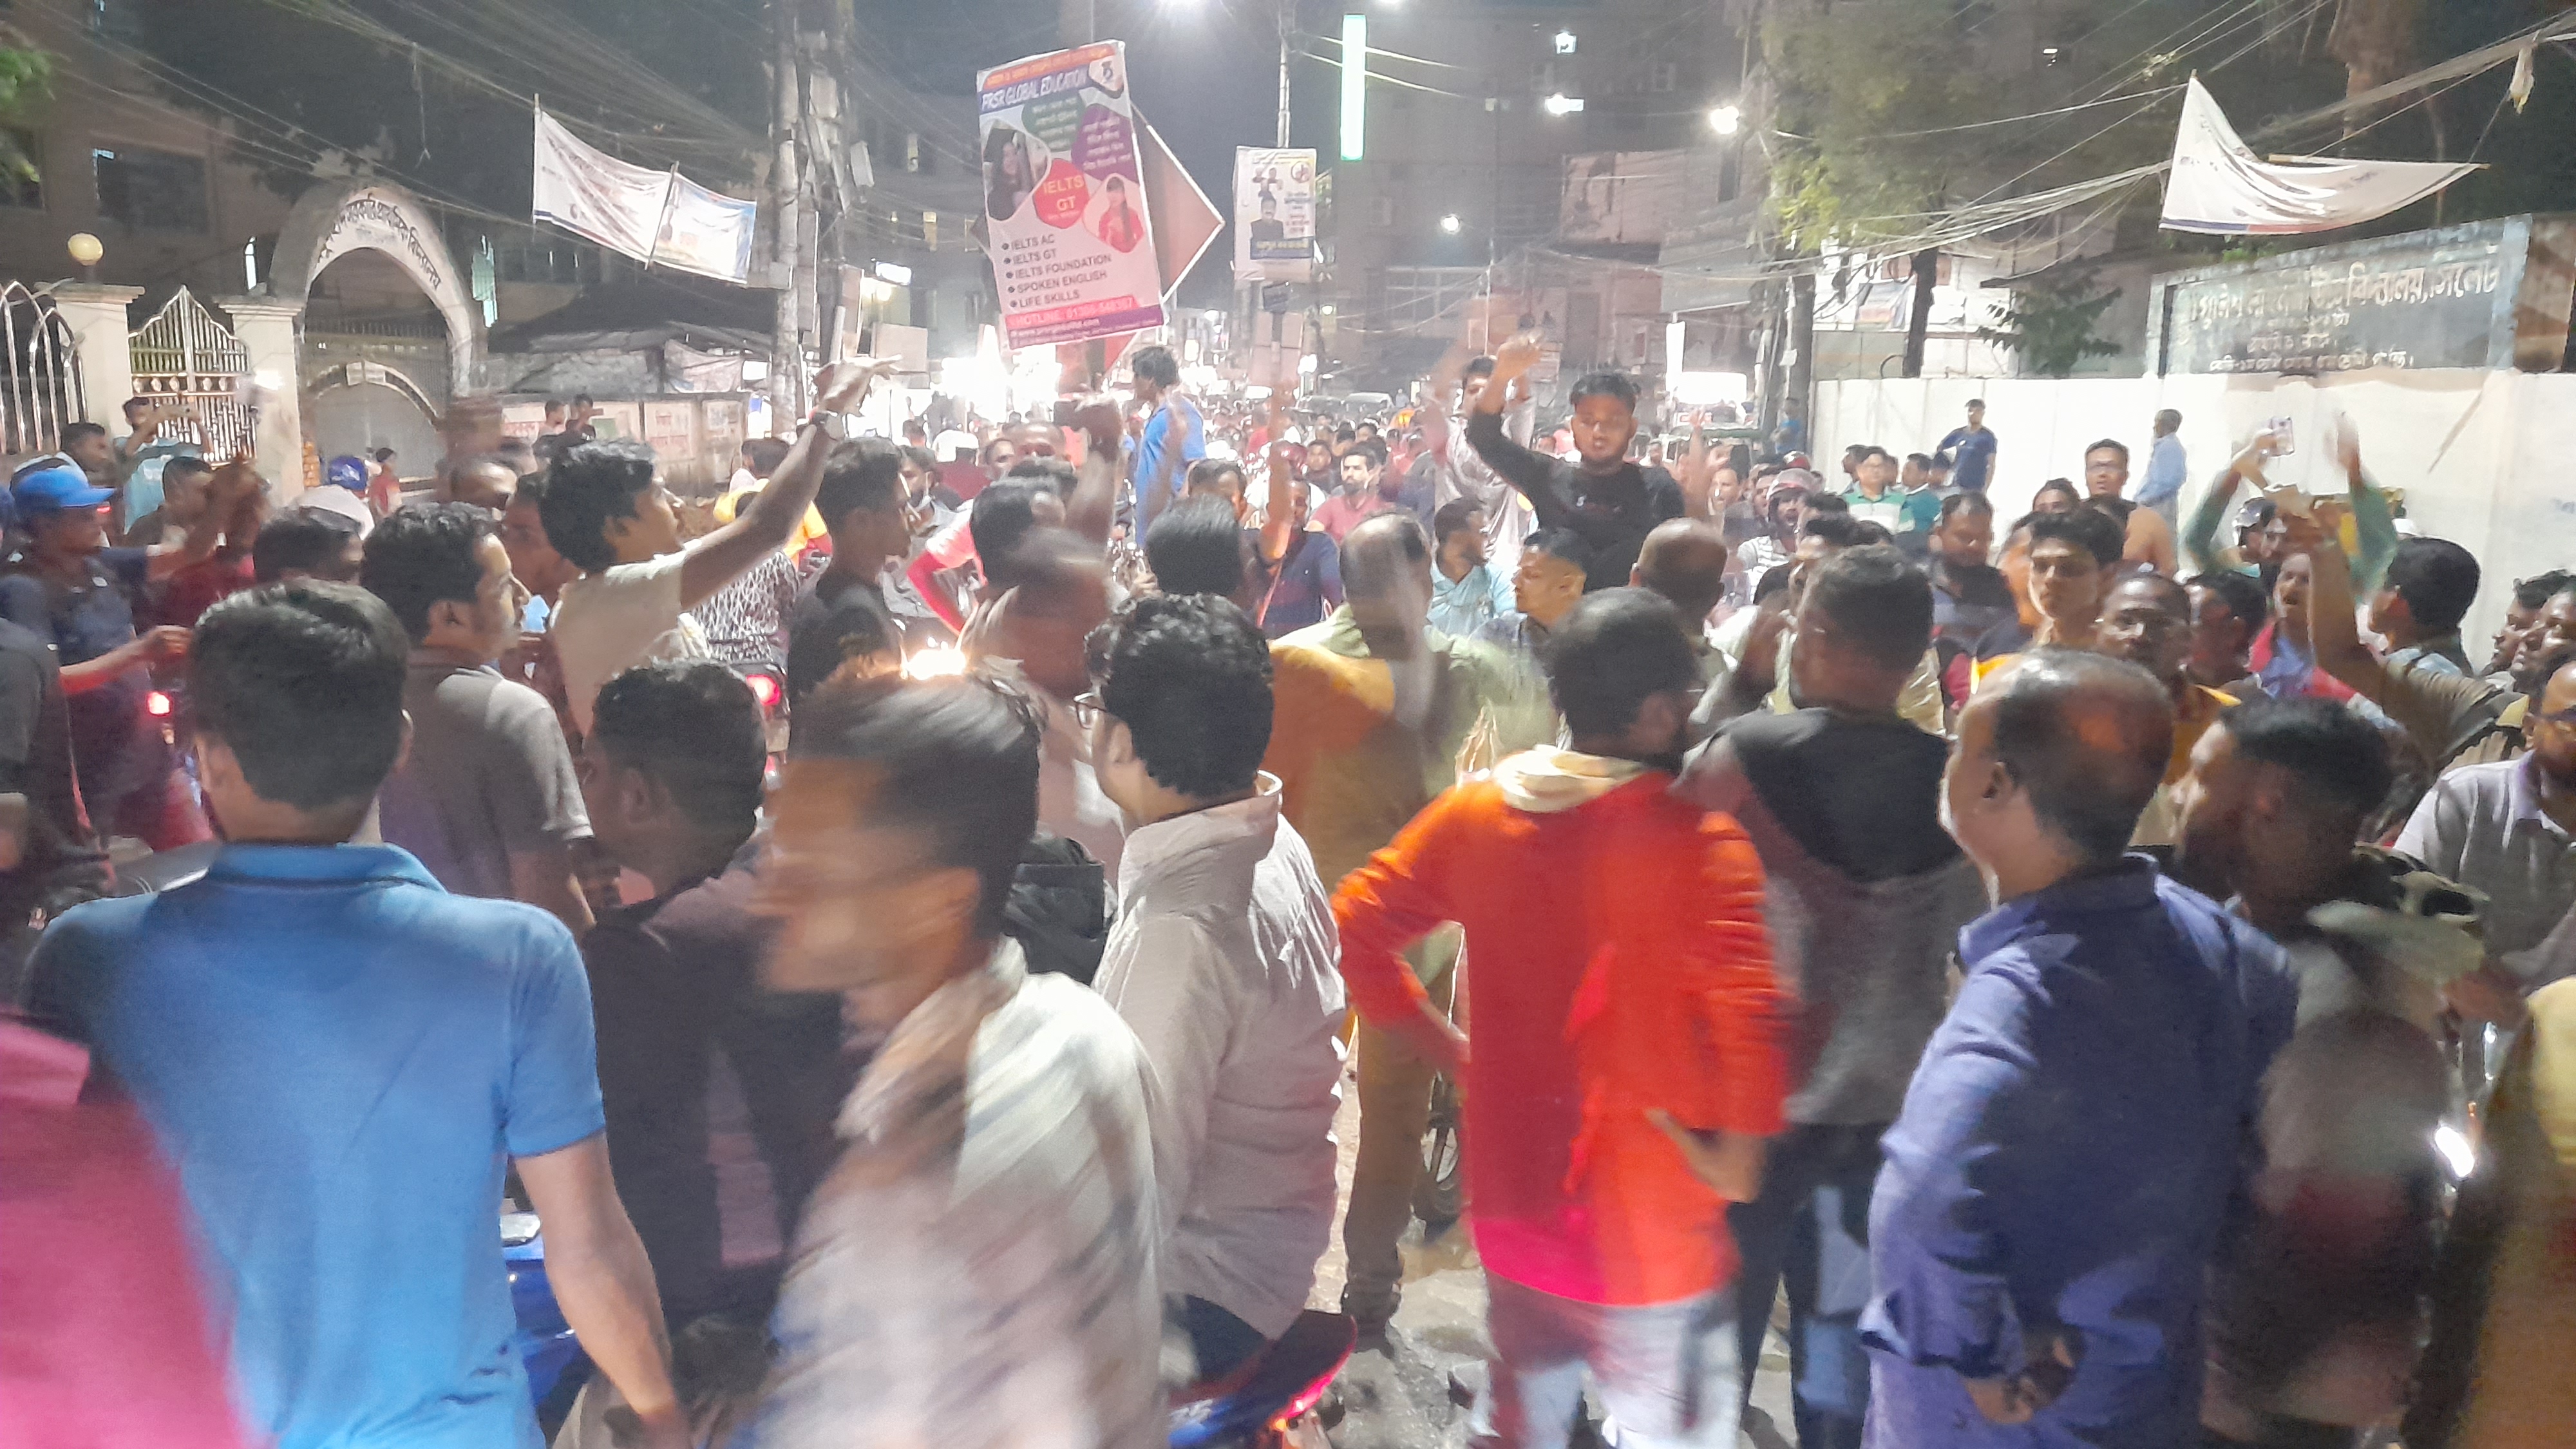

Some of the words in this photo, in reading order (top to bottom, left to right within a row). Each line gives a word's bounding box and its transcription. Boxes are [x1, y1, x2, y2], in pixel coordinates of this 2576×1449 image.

[1005, 81, 1039, 106] GLOBAL
[1040, 66, 1088, 97] EDUCATION
[1043, 175, 1084, 194] IELTS
[1056, 195, 1076, 211] GT
[1011, 238, 1039, 250] IELTS
[1041, 234, 1055, 244] AC
[1013, 251, 1041, 264] IELTS
[1043, 248, 1056, 260] GT
[1016, 265, 1043, 278] IELTS
[1045, 254, 1112, 274] FOUNDATION
[1016, 279, 1060, 293] SPOKEN
[1062, 270, 1108, 286] ENGLISH
[1019, 296, 1042, 308] LIFE
[1044, 290, 1080, 304] SKILLS
